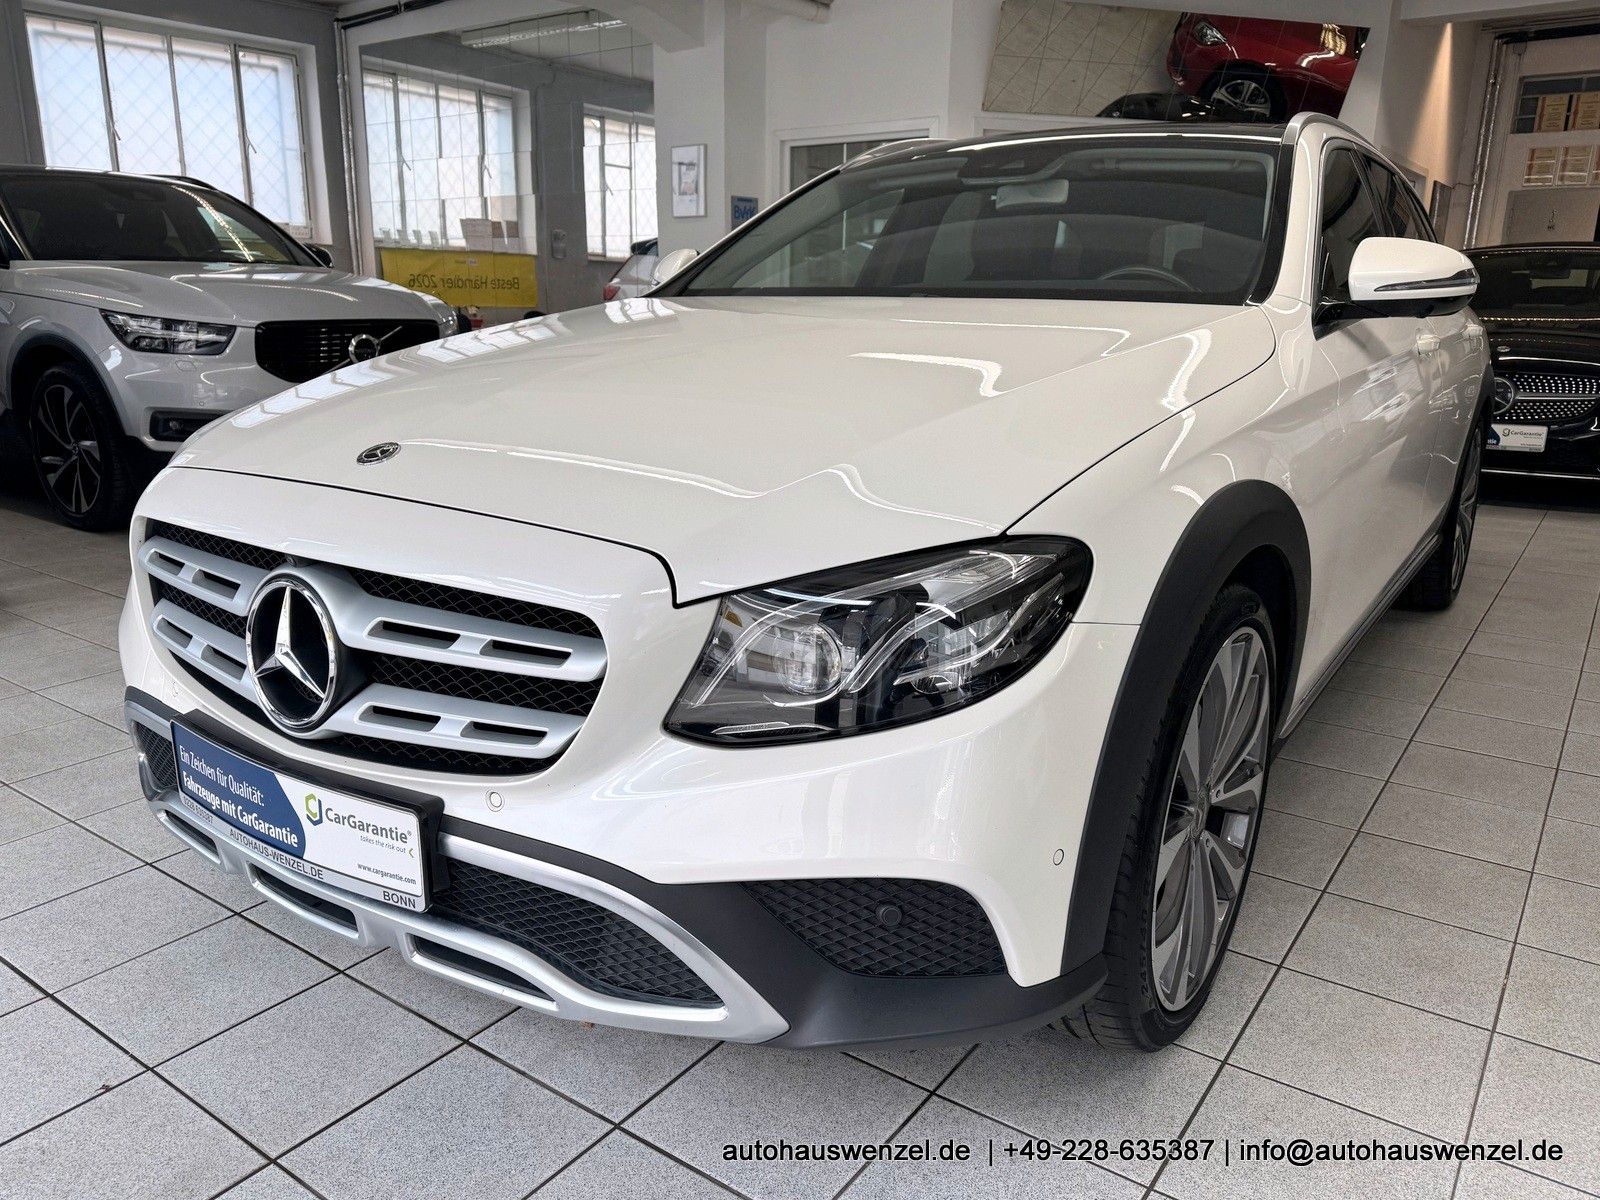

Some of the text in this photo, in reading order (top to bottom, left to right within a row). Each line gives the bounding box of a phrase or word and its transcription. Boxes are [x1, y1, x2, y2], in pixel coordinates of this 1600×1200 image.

[179, 745, 264, 806] Ein Zeichen für Qualität:
[182, 770, 298, 848] Fahrzeuge mit CarGarantie
[229, 829, 324, 880] AUTOHAUS-WENZEL.DE
[360, 835, 406, 854] takes the risk out
[357, 863, 417, 885] www.cargarantie.com
[383, 890, 416, 909] BONN
